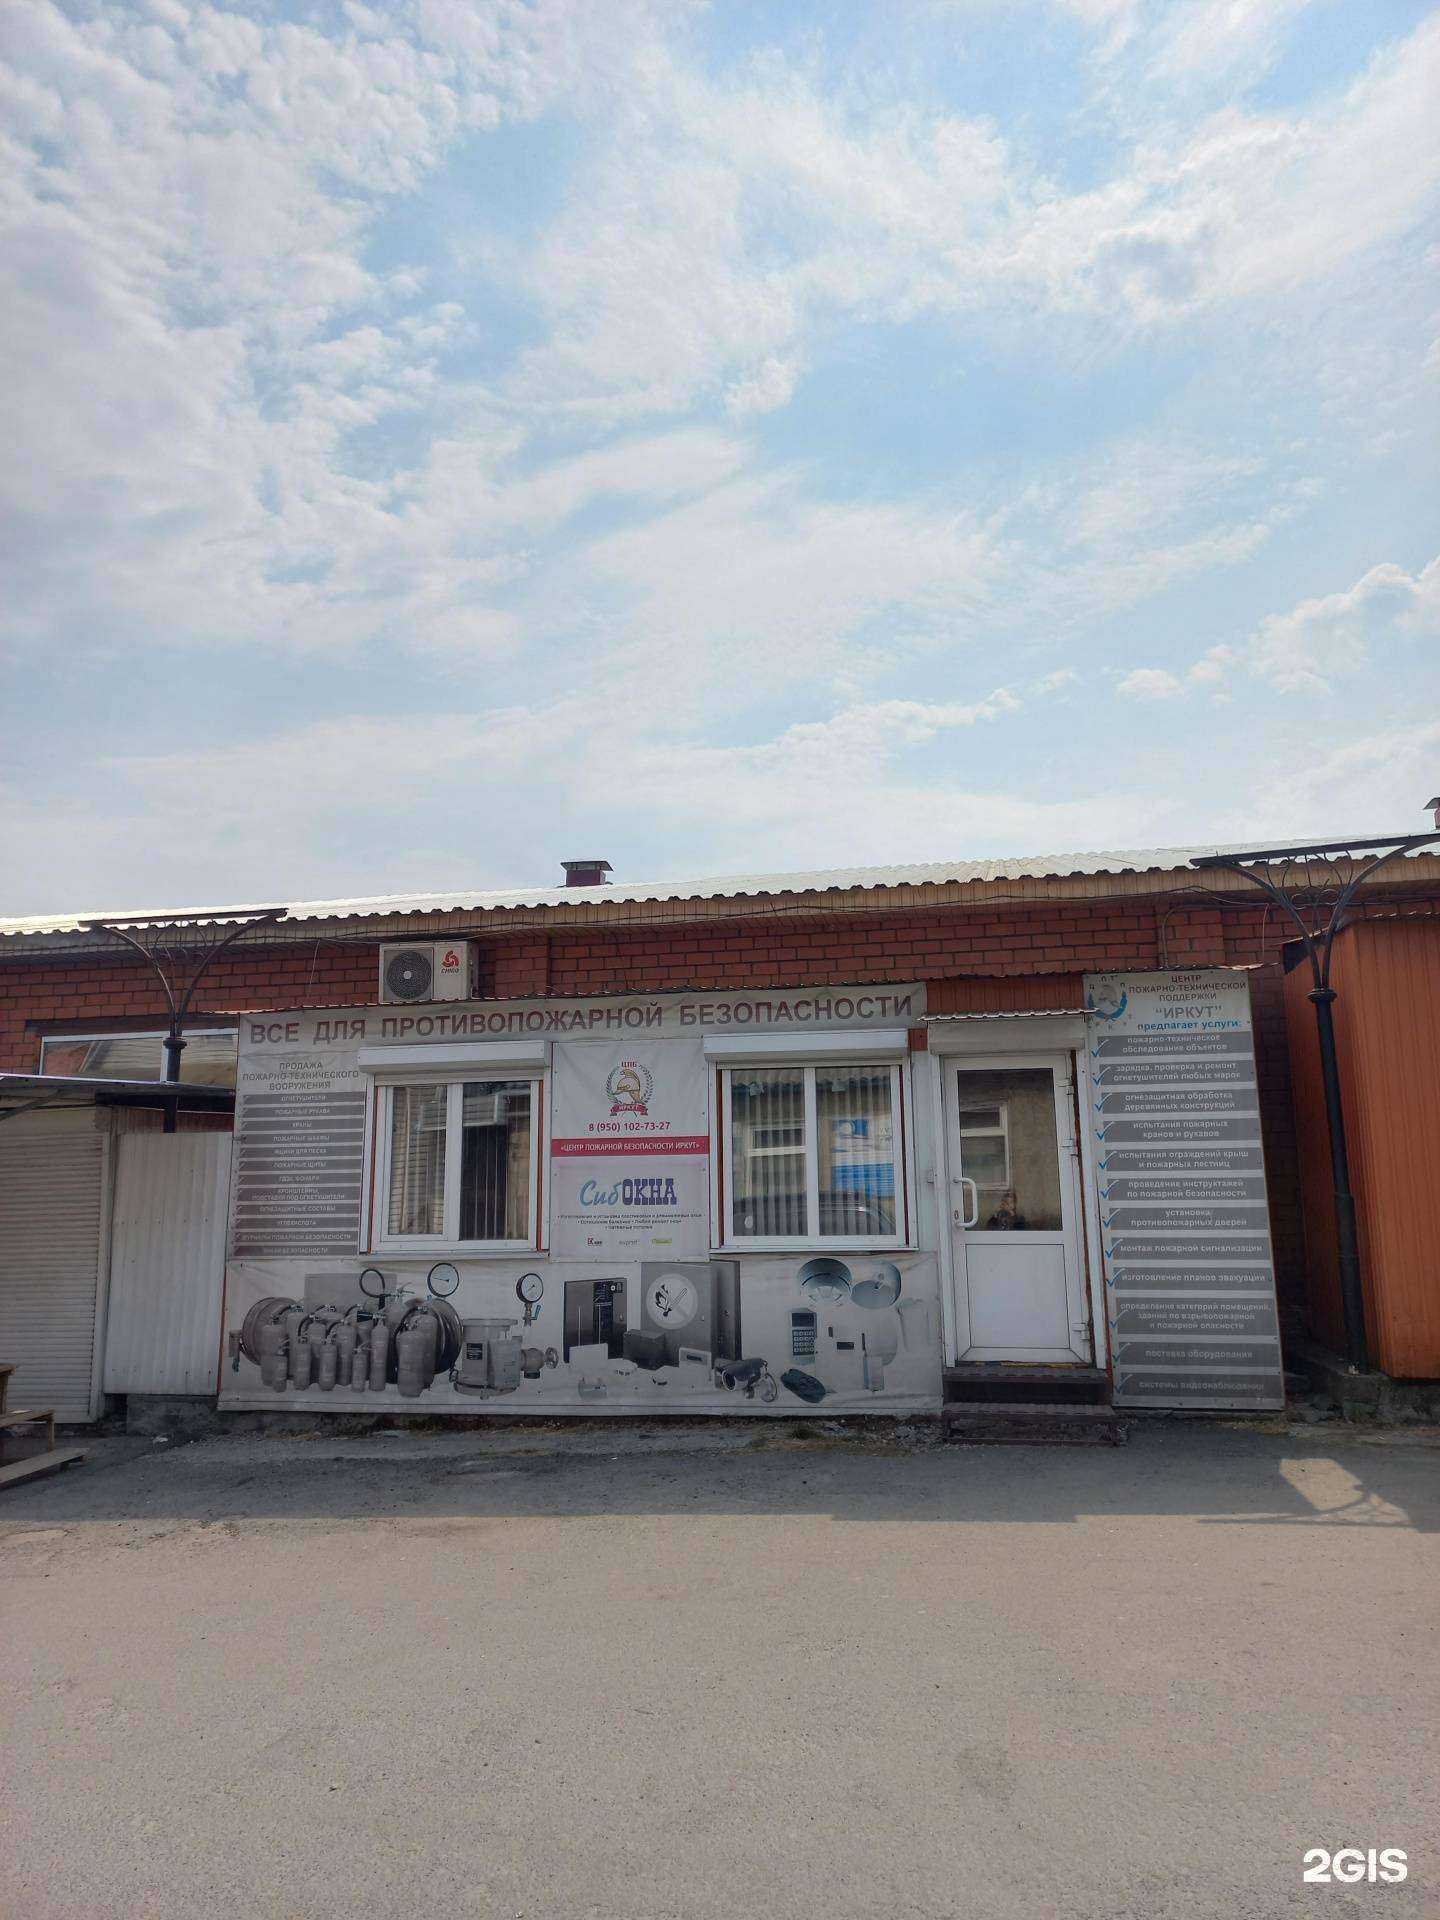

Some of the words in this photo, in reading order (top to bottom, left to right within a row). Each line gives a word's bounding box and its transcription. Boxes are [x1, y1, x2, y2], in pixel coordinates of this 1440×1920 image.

[1171, 975, 1202, 983] ЦЕНТР
[1129, 981, 1246, 993] ПОЖАРНО-ТЕХНИЧЕСКОЙ
[1159, 993, 1217, 1002] ПОДДЕРЖКИ
[250, 1023, 300, 1044] ВСЕ
[313, 1019, 366, 1044] ДЛЯ
[382, 1002, 663, 1038] ПРОТИВОПОЖАРНОЙ
[680, 996, 912, 1026] БЕЗОПАСНОСТИ
[1138, 1022, 1198, 1032] предлагает
[280, 1062, 323, 1071] ПРОДАЖА
[242, 1070, 359, 1081] ПОЖАРНО-ТЕХНИЧЕСКОГО
[269, 1081, 331, 1090] ВООРУЖЕНИЯ
[589, 1124, 594, 1132] 8
[596, 1122, 620, 1133] (950)
[624, 1121, 671, 1131] 102-73-27
[585, 1143, 623, 1151] ПОЖАРНОЙ
[624, 1142, 674, 1151] БЕЗОПАСНОСТИ
